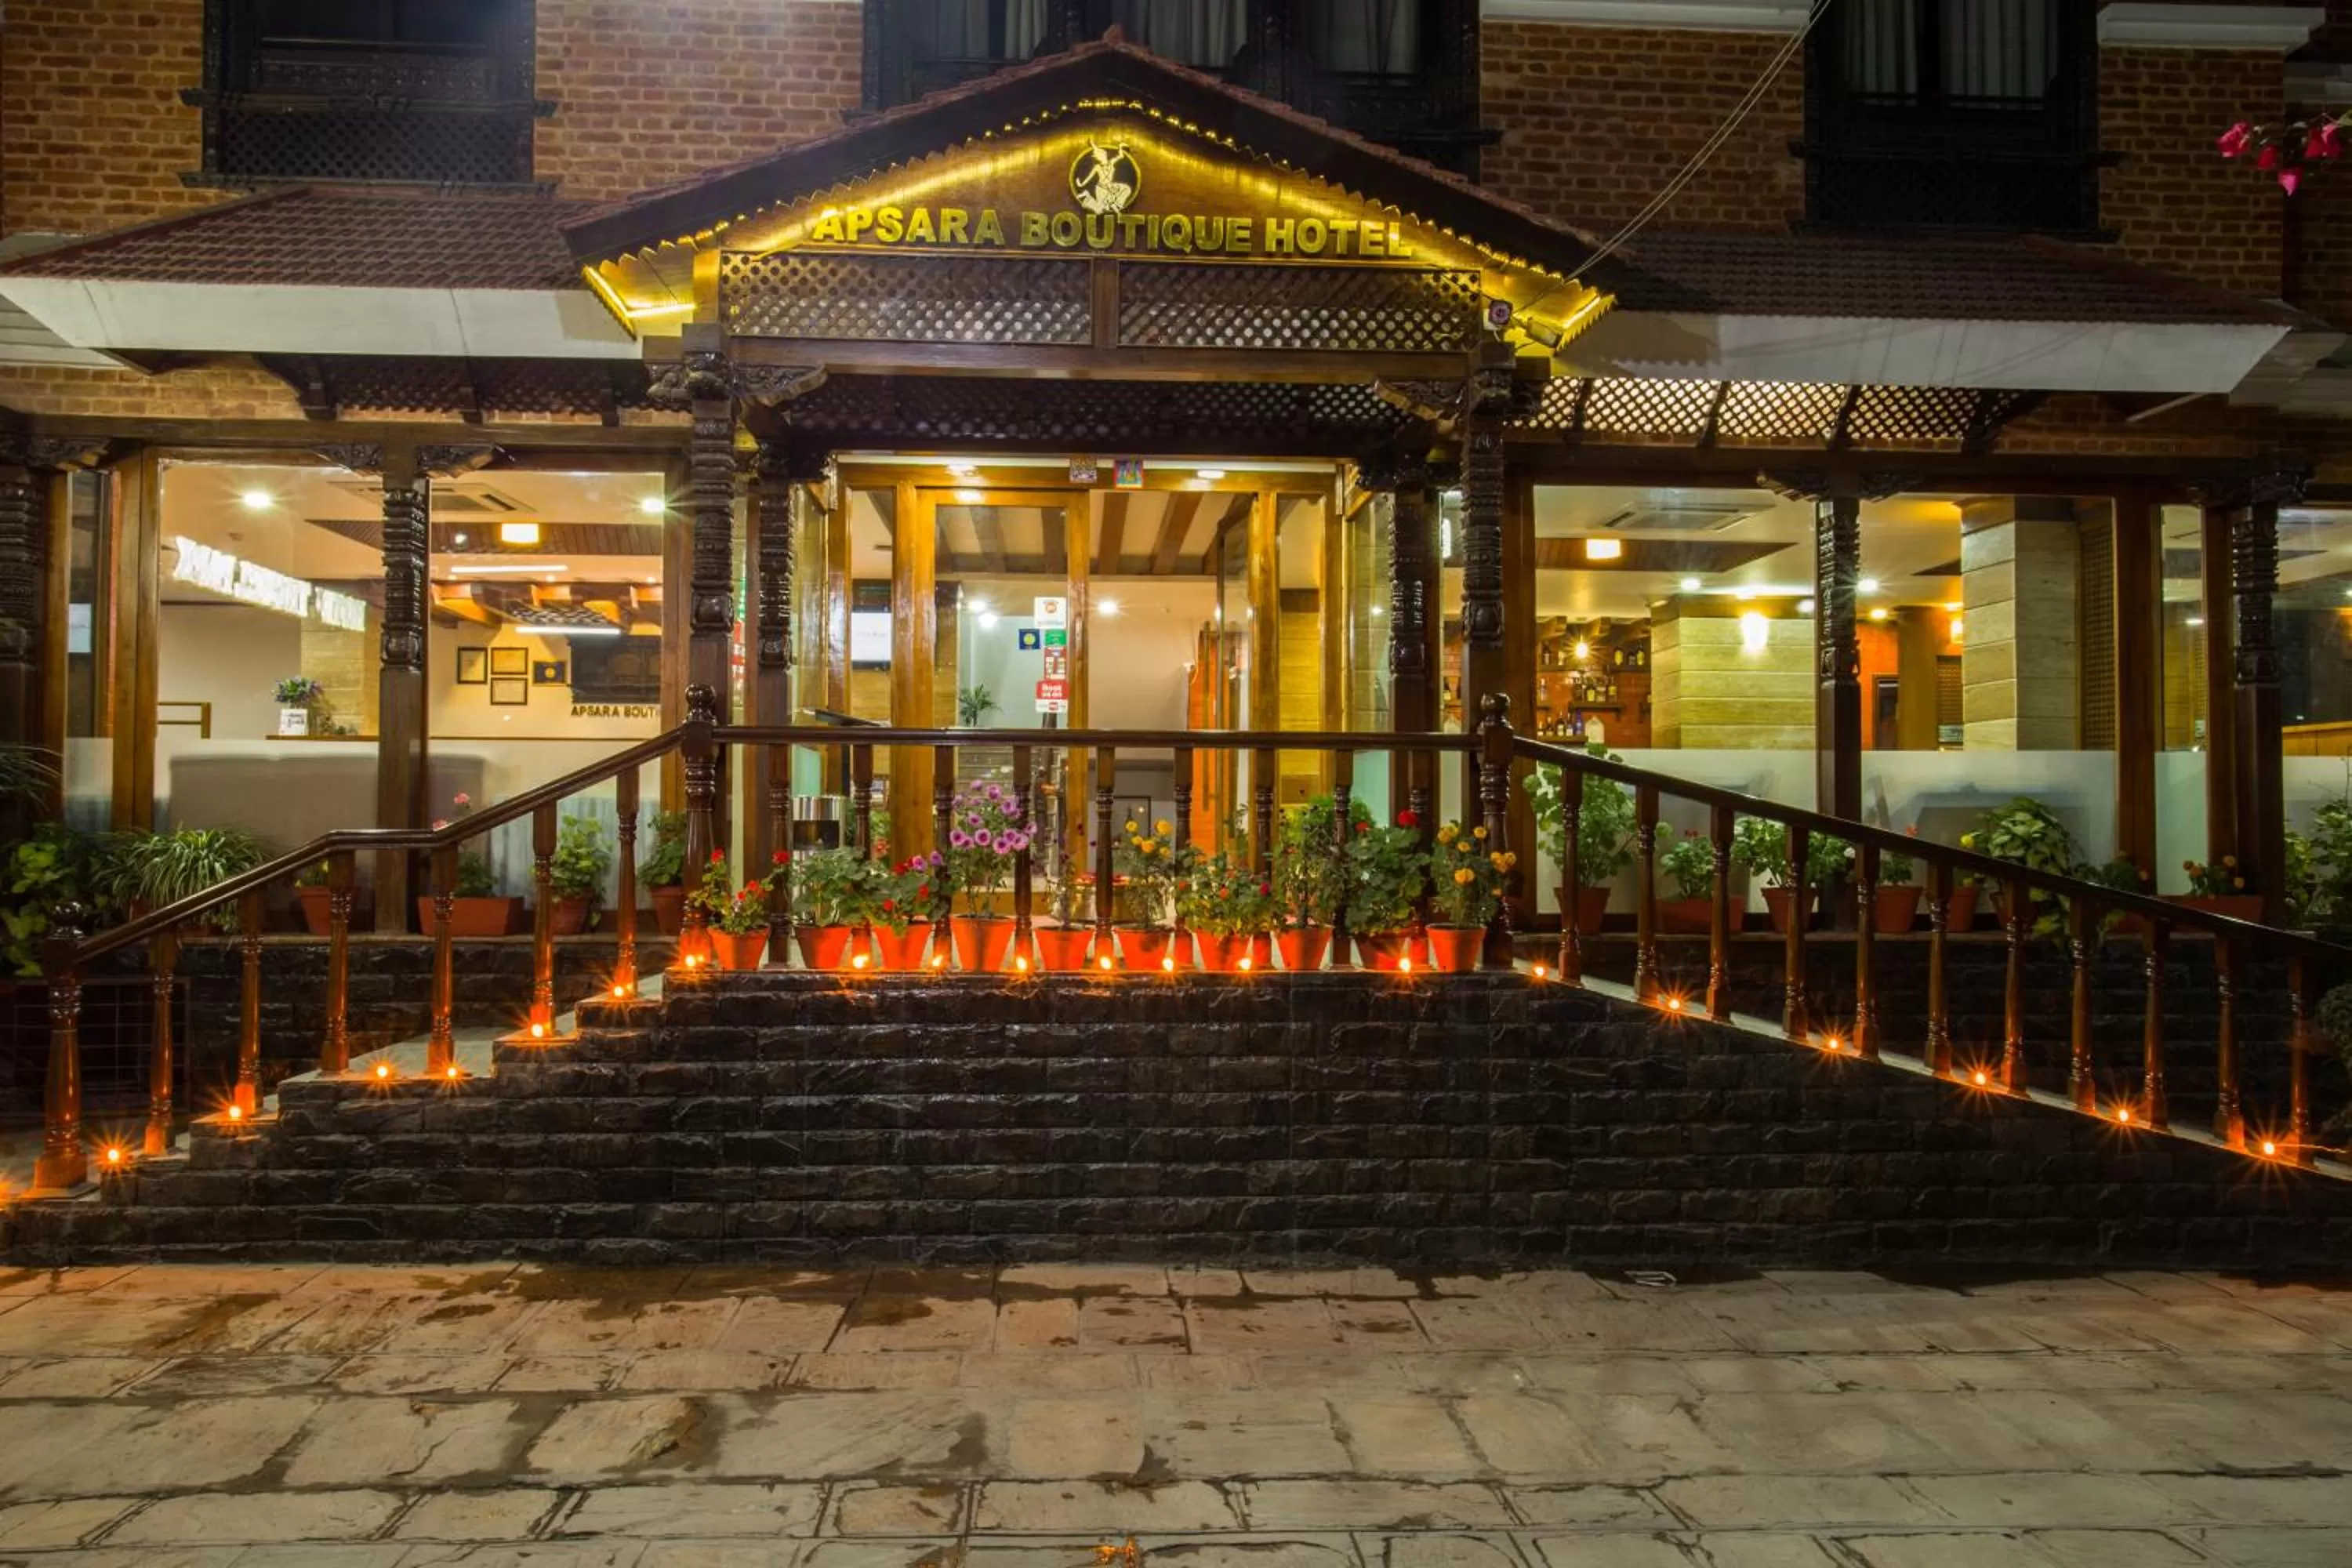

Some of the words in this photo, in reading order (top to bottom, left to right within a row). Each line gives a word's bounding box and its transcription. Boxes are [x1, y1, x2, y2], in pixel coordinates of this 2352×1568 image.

[812, 206, 1005, 245] APSARA
[1020, 211, 1252, 252] BOUTIQUE
[1265, 217, 1412, 256] HOTEL
[571, 705, 619, 717] APSARA
